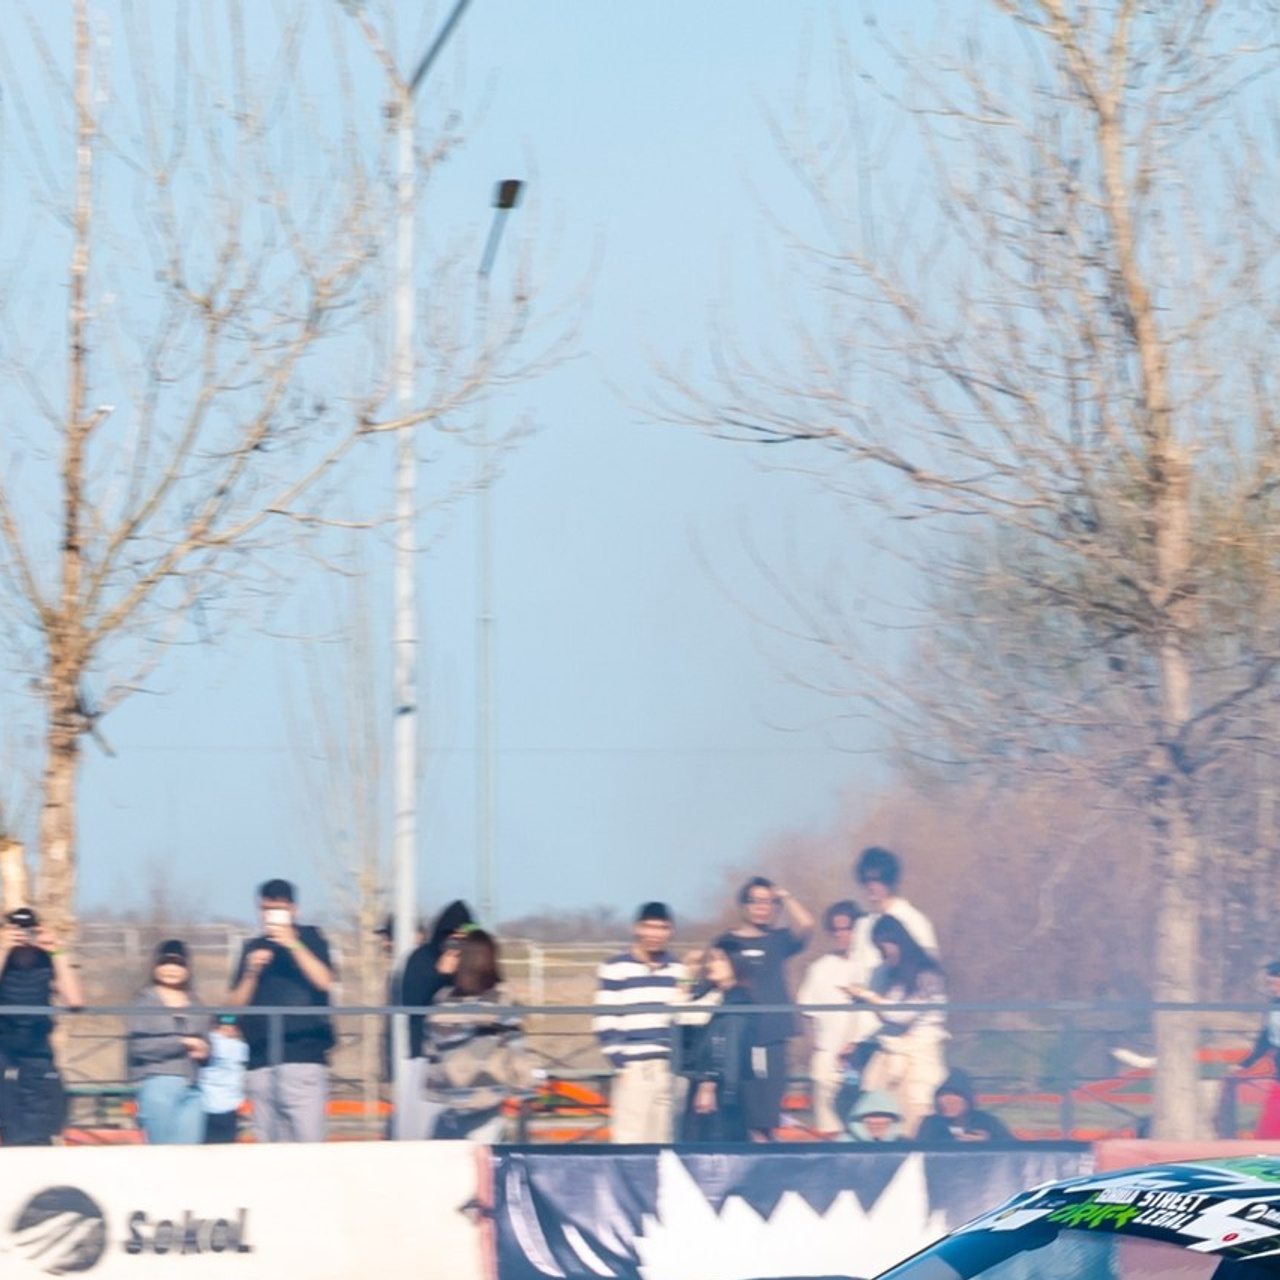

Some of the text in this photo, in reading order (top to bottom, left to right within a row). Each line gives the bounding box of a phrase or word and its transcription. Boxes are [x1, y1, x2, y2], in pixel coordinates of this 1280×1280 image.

[1137, 1190, 1211, 1213] STREET
[1132, 1207, 1195, 1230] LEGAL
[125, 1208, 253, 1255] Sokol
